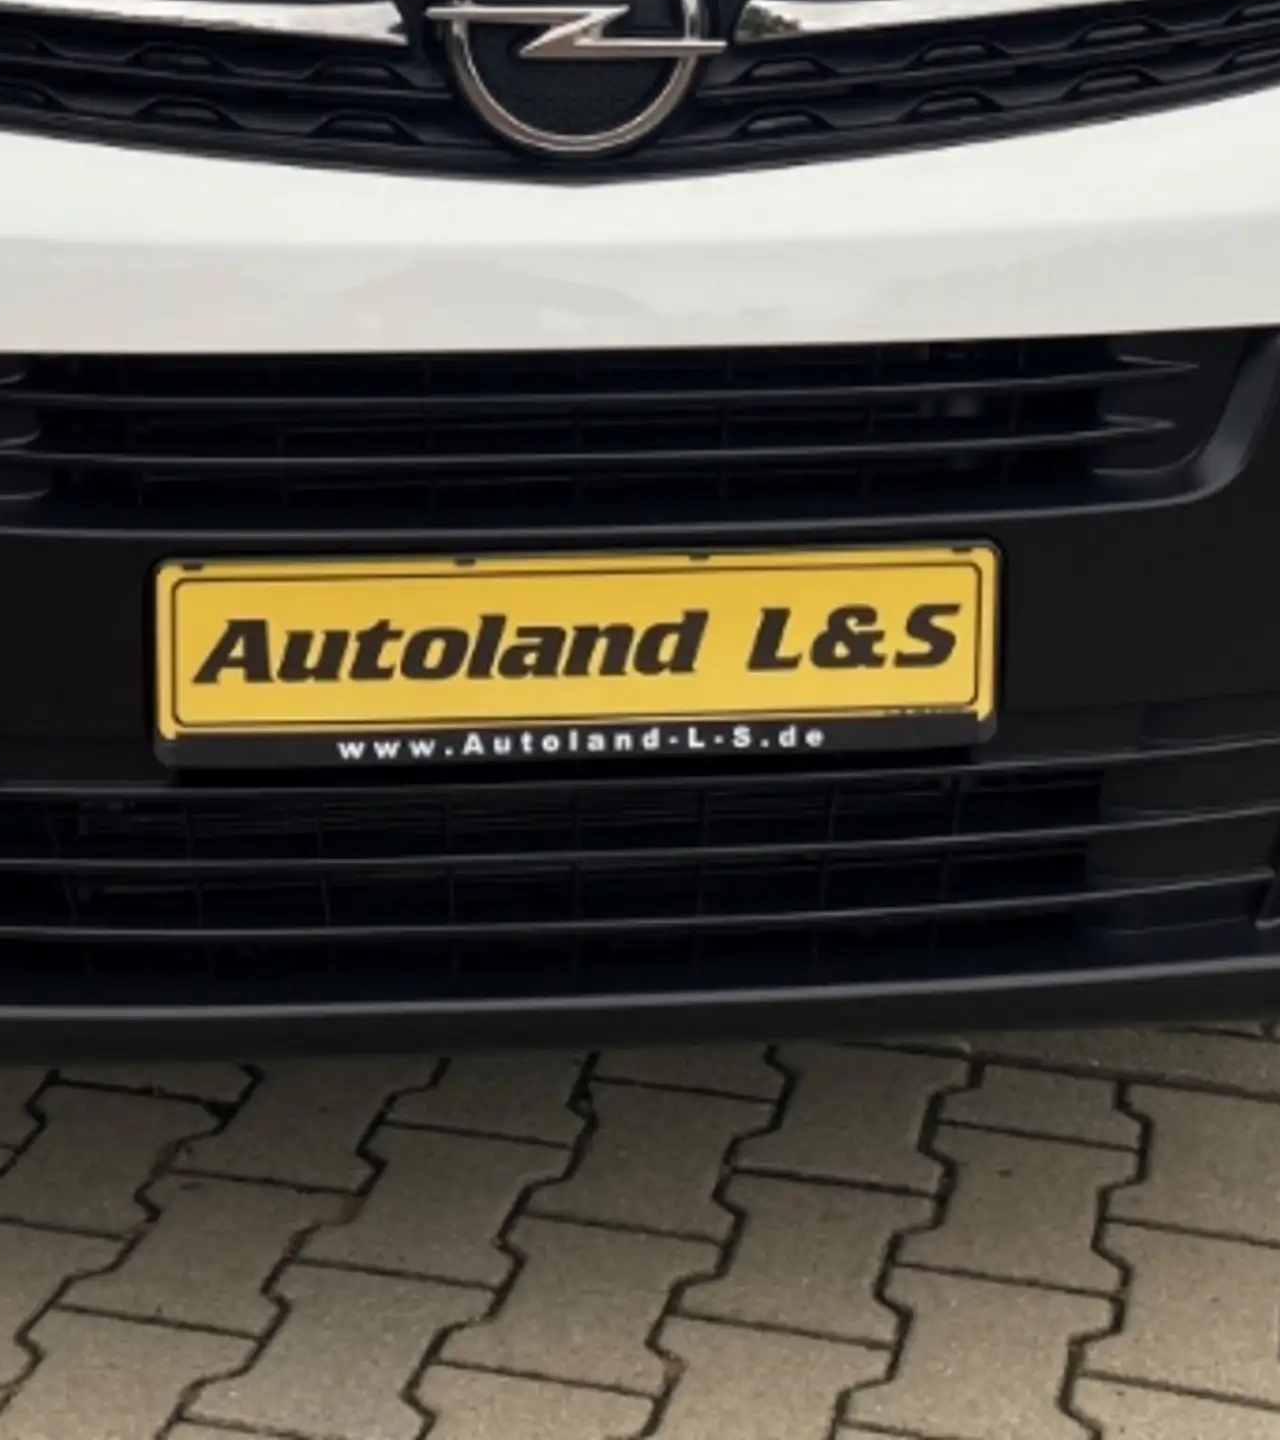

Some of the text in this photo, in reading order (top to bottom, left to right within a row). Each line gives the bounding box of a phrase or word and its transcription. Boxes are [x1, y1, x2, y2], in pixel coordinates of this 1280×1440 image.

[191, 602, 962, 685] Autoland L&S
[336, 725, 826, 761] www.Autoland-L-S.de
